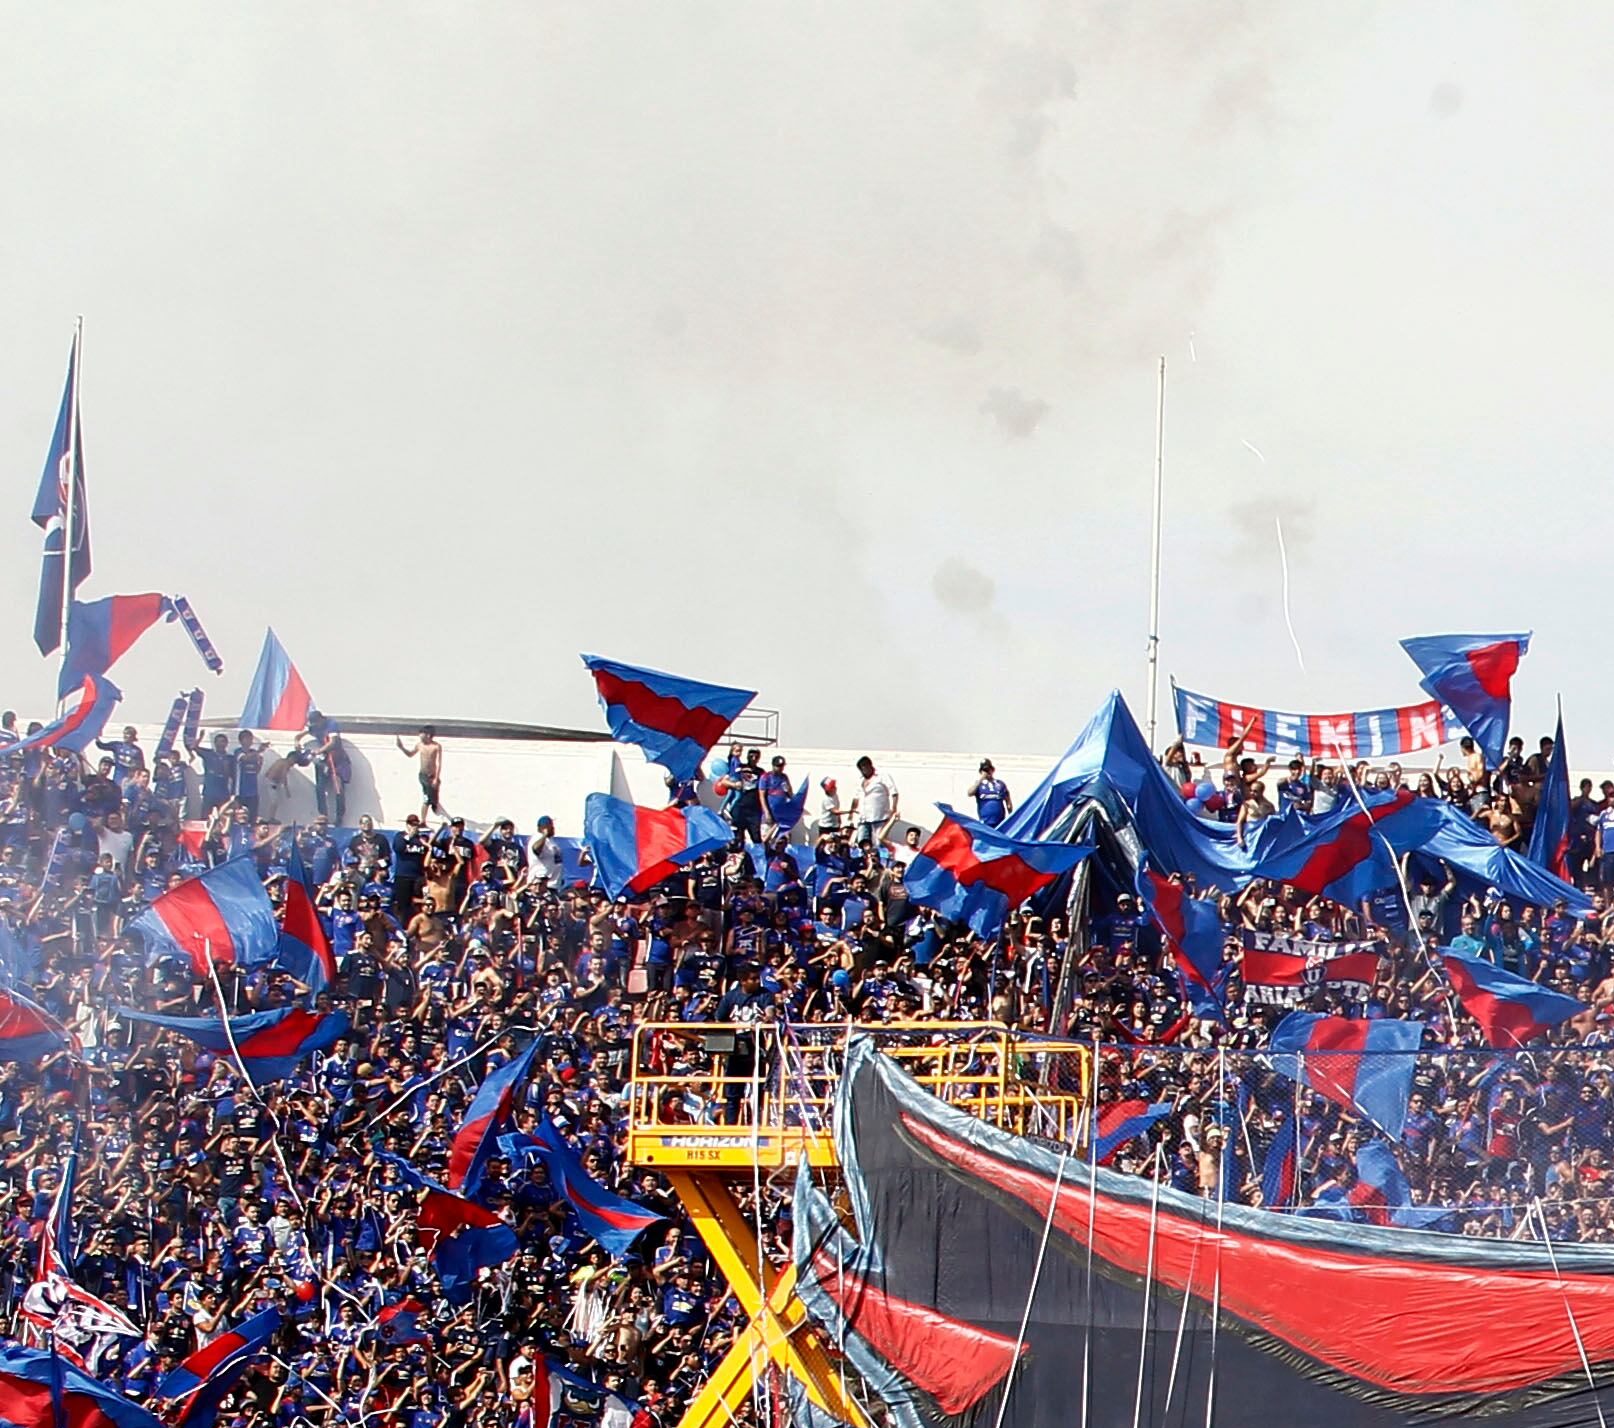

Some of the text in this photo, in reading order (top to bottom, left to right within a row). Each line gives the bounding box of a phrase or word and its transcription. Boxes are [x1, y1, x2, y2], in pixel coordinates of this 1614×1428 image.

[672, 1137, 758, 1148] HORIZON
[687, 1151, 721, 1161] H15 SX
